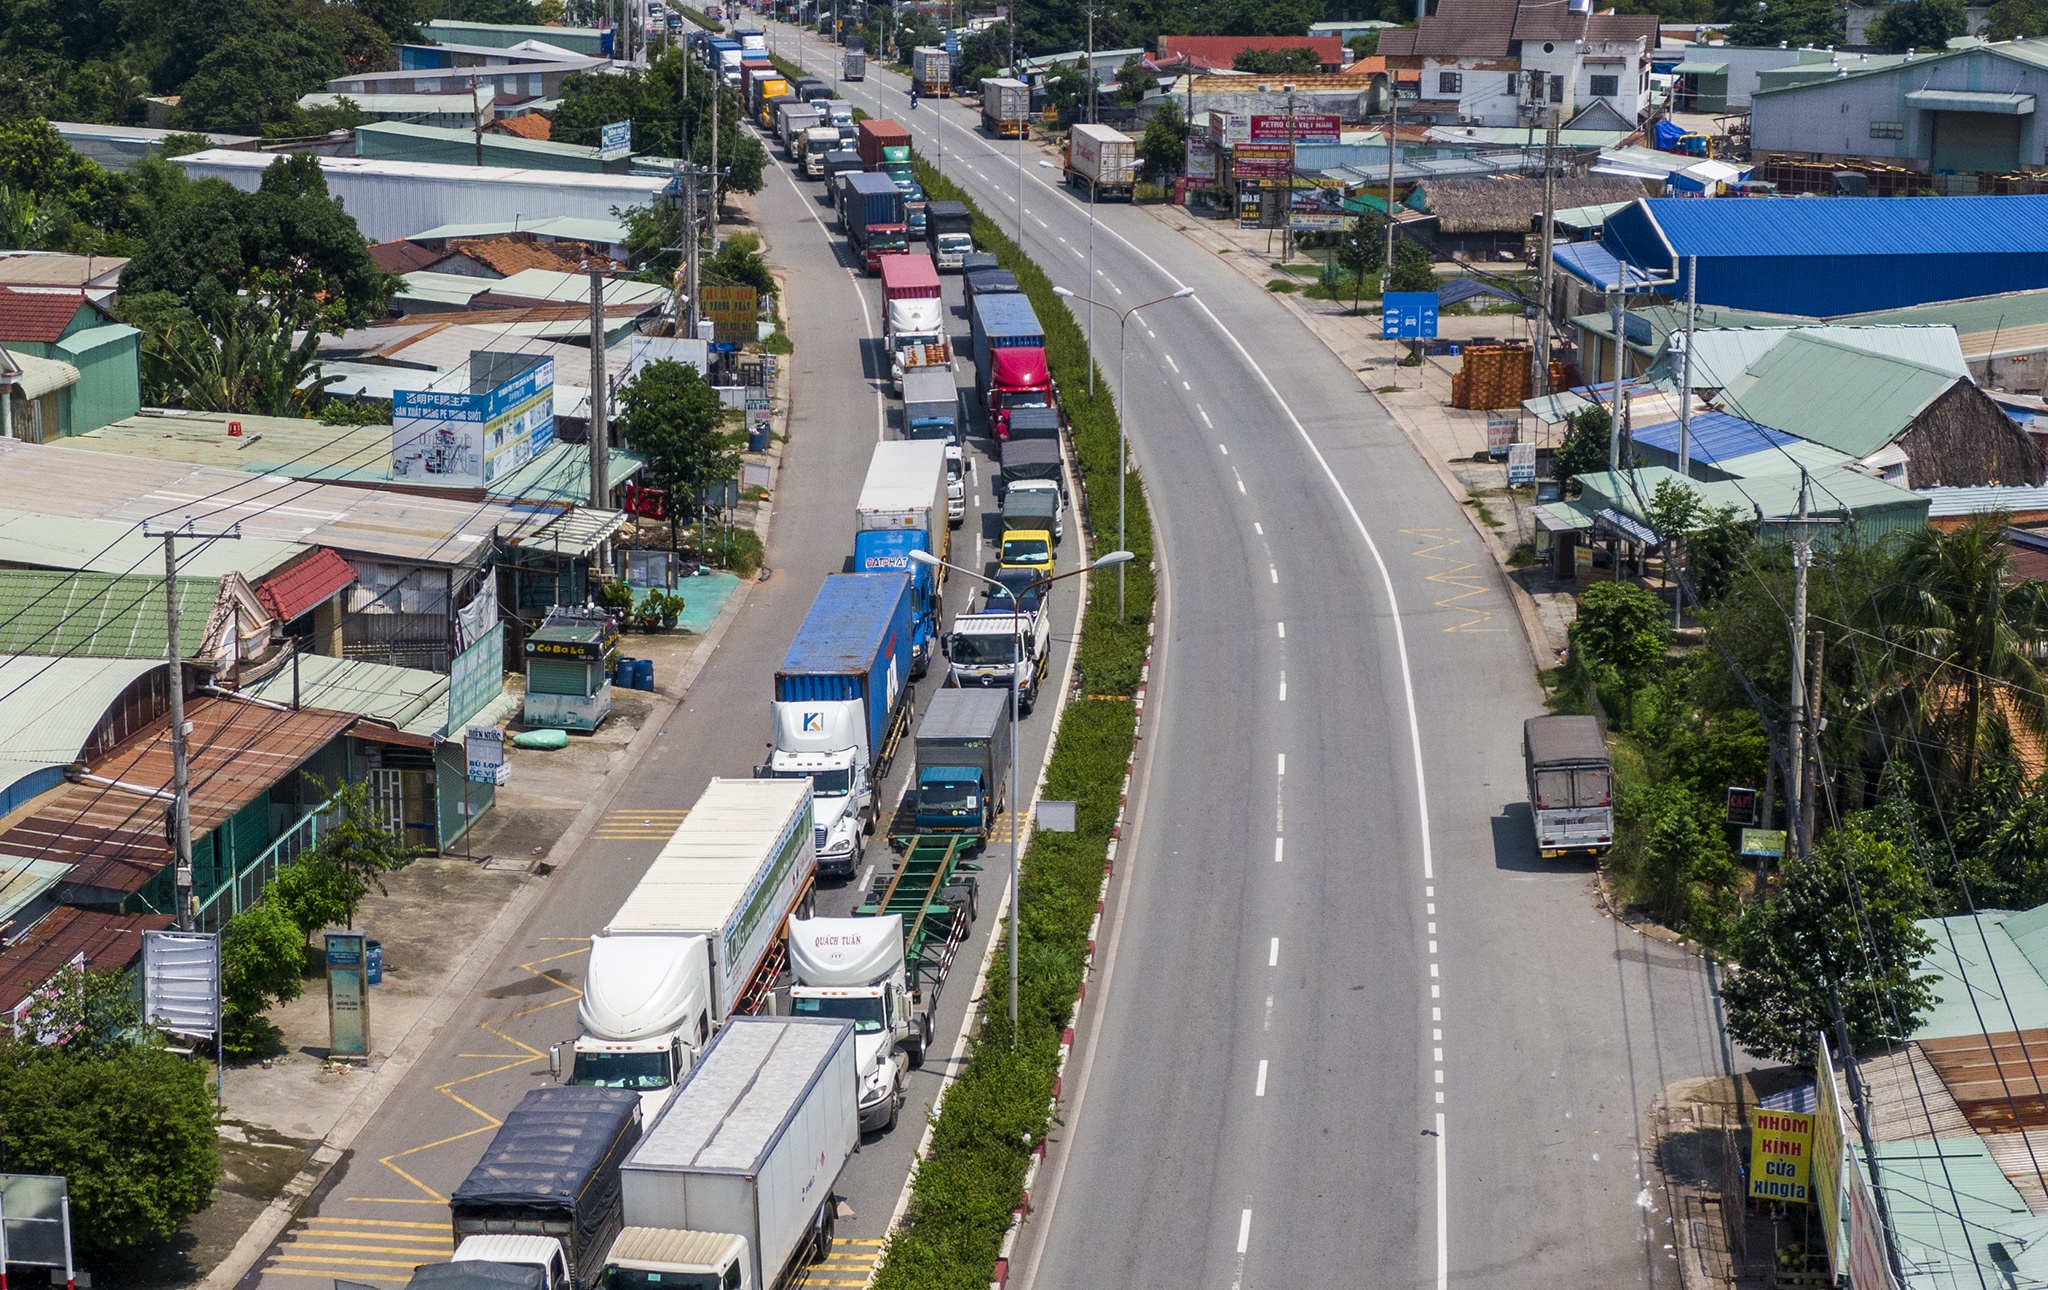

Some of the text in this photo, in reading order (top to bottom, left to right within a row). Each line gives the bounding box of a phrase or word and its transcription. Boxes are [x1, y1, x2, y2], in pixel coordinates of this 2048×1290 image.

[406, 392, 471, 406] 透明PE膜生产
[407, 405, 422, 417] XUẤT
[440, 409, 448, 419] PE
[448, 410, 466, 420] TRONG
[467, 408, 482, 421] SUỐT
[552, 644, 569, 654] Ba
[569, 645, 585, 655] Lá
[469, 759, 481, 767] BÙ
[469, 767, 482, 775] ỐC
[815, 933, 861, 948] QUÁCH TUẤN
[1757, 1115, 1808, 1133] NHÔM
[1762, 1137, 1802, 1157] KÍNH
[1766, 1158, 1795, 1177] cửa
